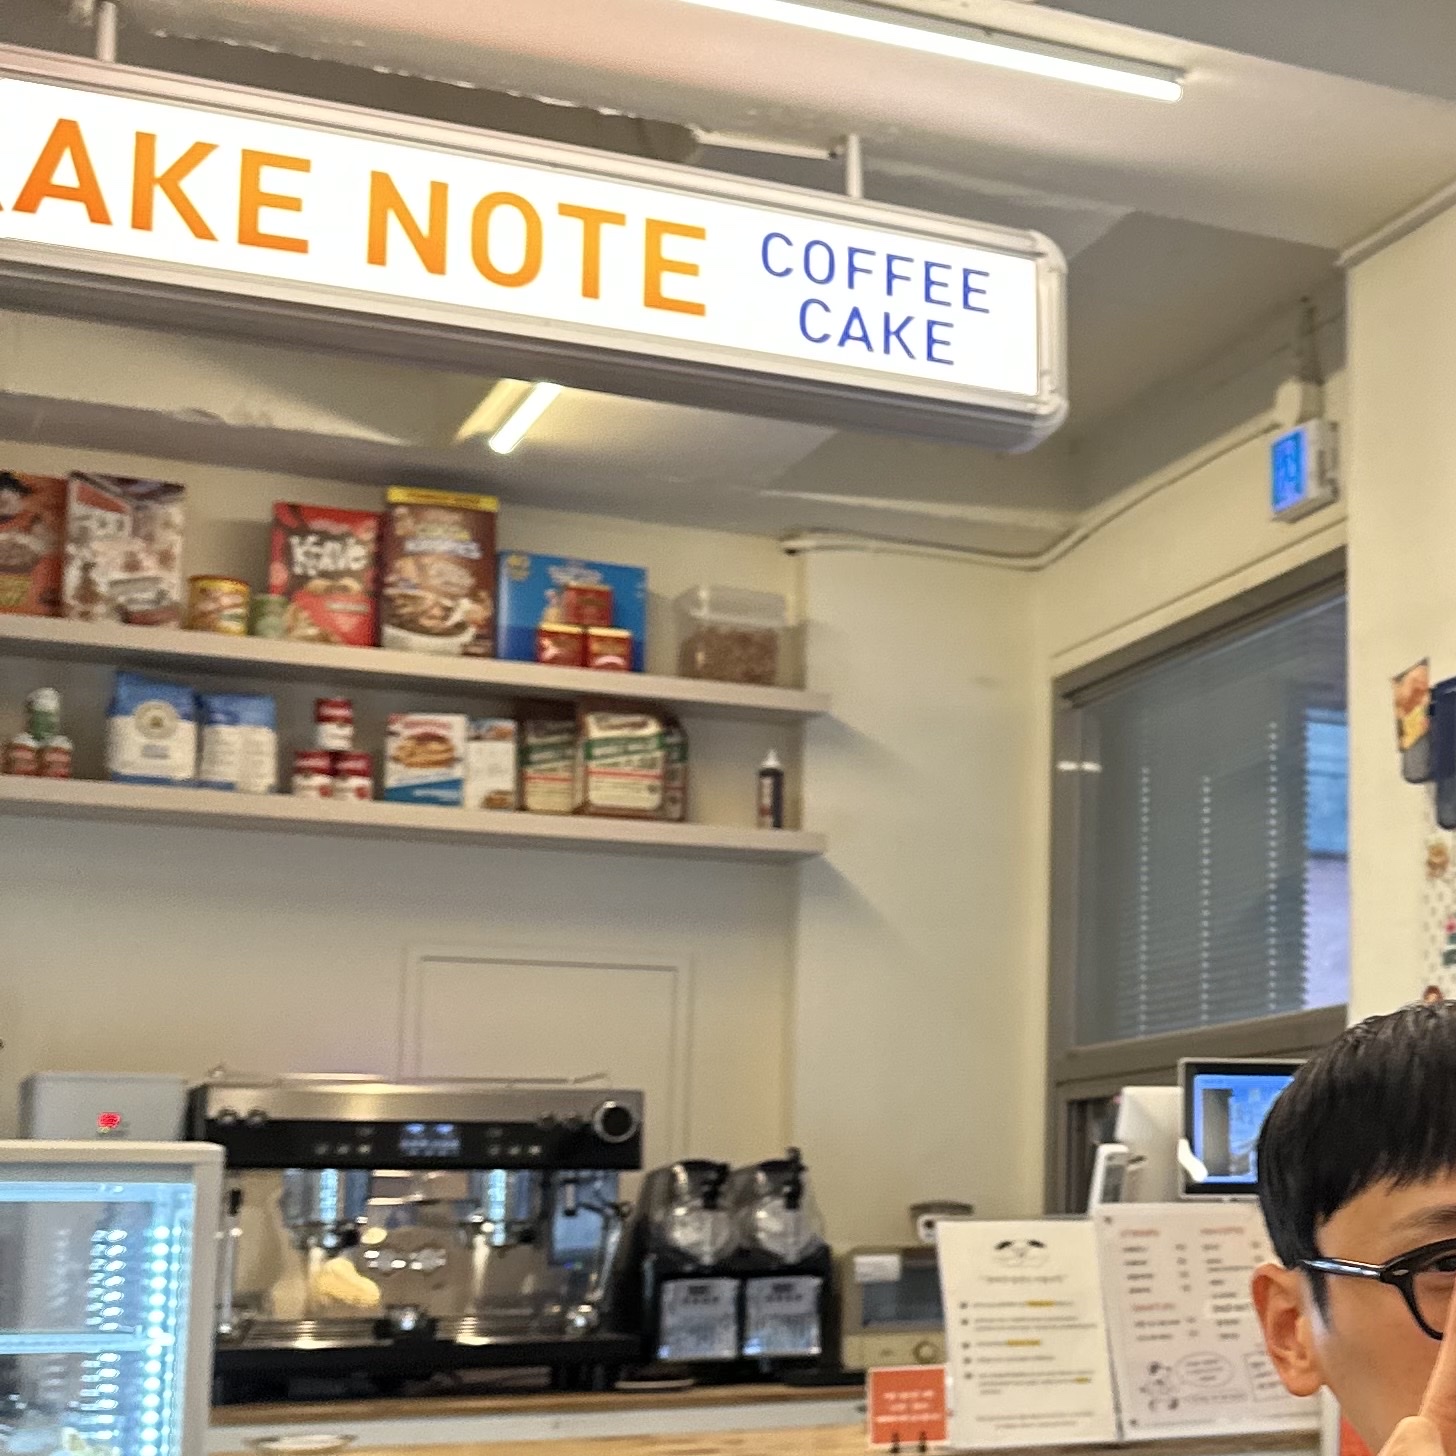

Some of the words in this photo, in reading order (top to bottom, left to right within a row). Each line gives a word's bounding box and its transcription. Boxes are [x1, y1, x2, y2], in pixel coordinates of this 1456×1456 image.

[0, 117, 312, 254] AKE
[366, 170, 706, 317] NOTE
[761, 231, 991, 314] COFFEE
[798, 298, 955, 366] CAKE
